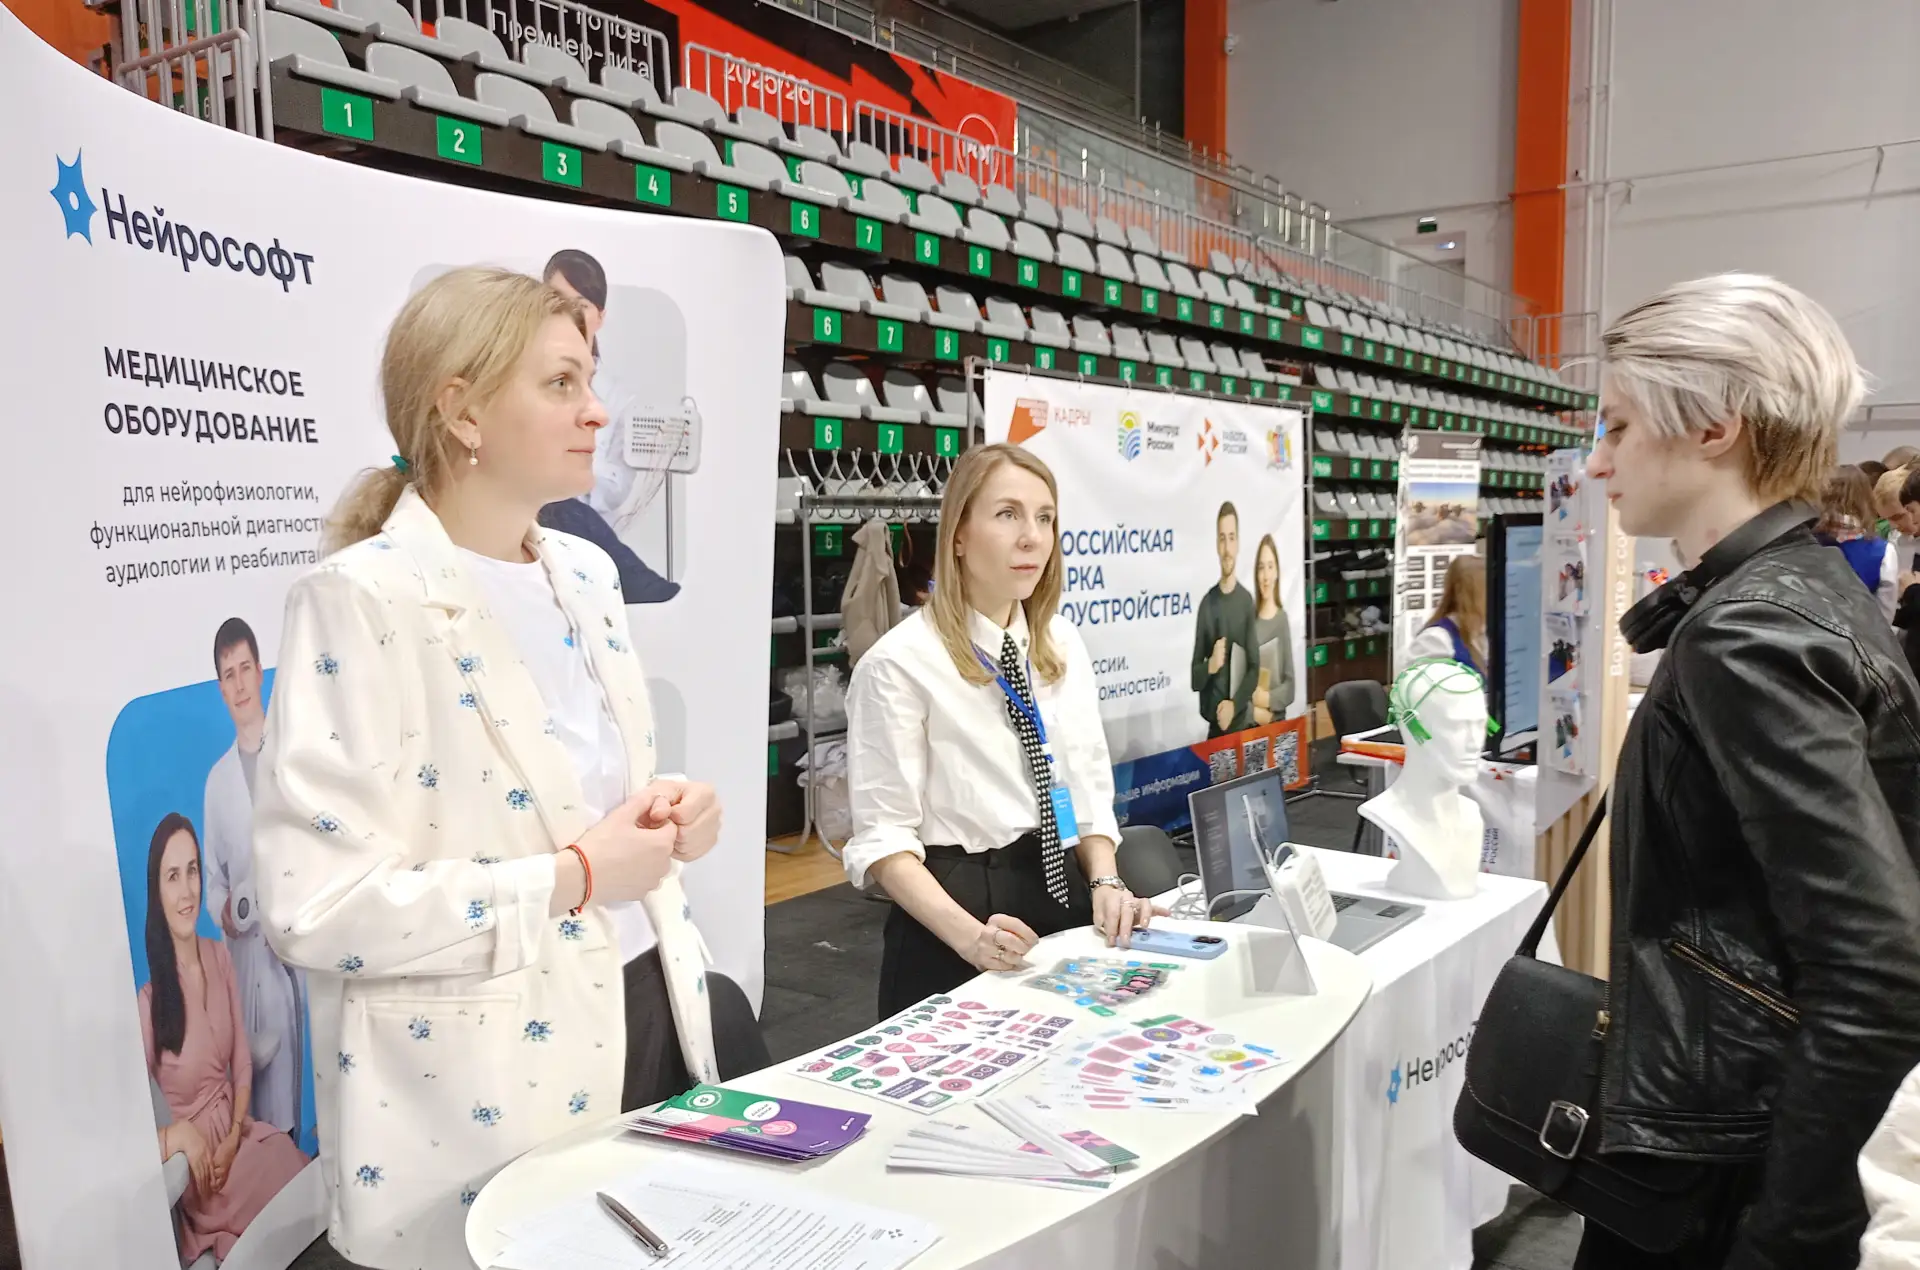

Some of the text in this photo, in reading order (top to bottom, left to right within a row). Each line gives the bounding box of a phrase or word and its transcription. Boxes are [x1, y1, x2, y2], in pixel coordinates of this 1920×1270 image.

[343, 103, 353, 127] 1
[454, 129, 465, 153] 2
[557, 153, 568, 176] 3
[648, 175, 658, 197] 4
[728, 193, 737, 213] 5
[801, 210, 810, 229] 6
[101, 187, 315, 293] Нейрософт
[866, 225, 873, 244] 7
[924, 240, 931, 258] 8
[823, 316, 832, 335] 6
[887, 326, 895, 345] 7
[104, 346, 305, 397] МЕДИЦИНСКОЕ
[104, 402, 319, 444] ОБОРУДОВАНИЕ
[824, 425, 833, 444] 6
[887, 430, 895, 448] 7
[123, 480, 319, 507] для нейрофизиологии,
[90, 515, 242, 549] функциональной
[825, 532, 833, 550] 6
[106, 553, 211, 588] аудиологии
[215, 554, 226, 572] и
[1062, 565, 1105, 592] РКА
